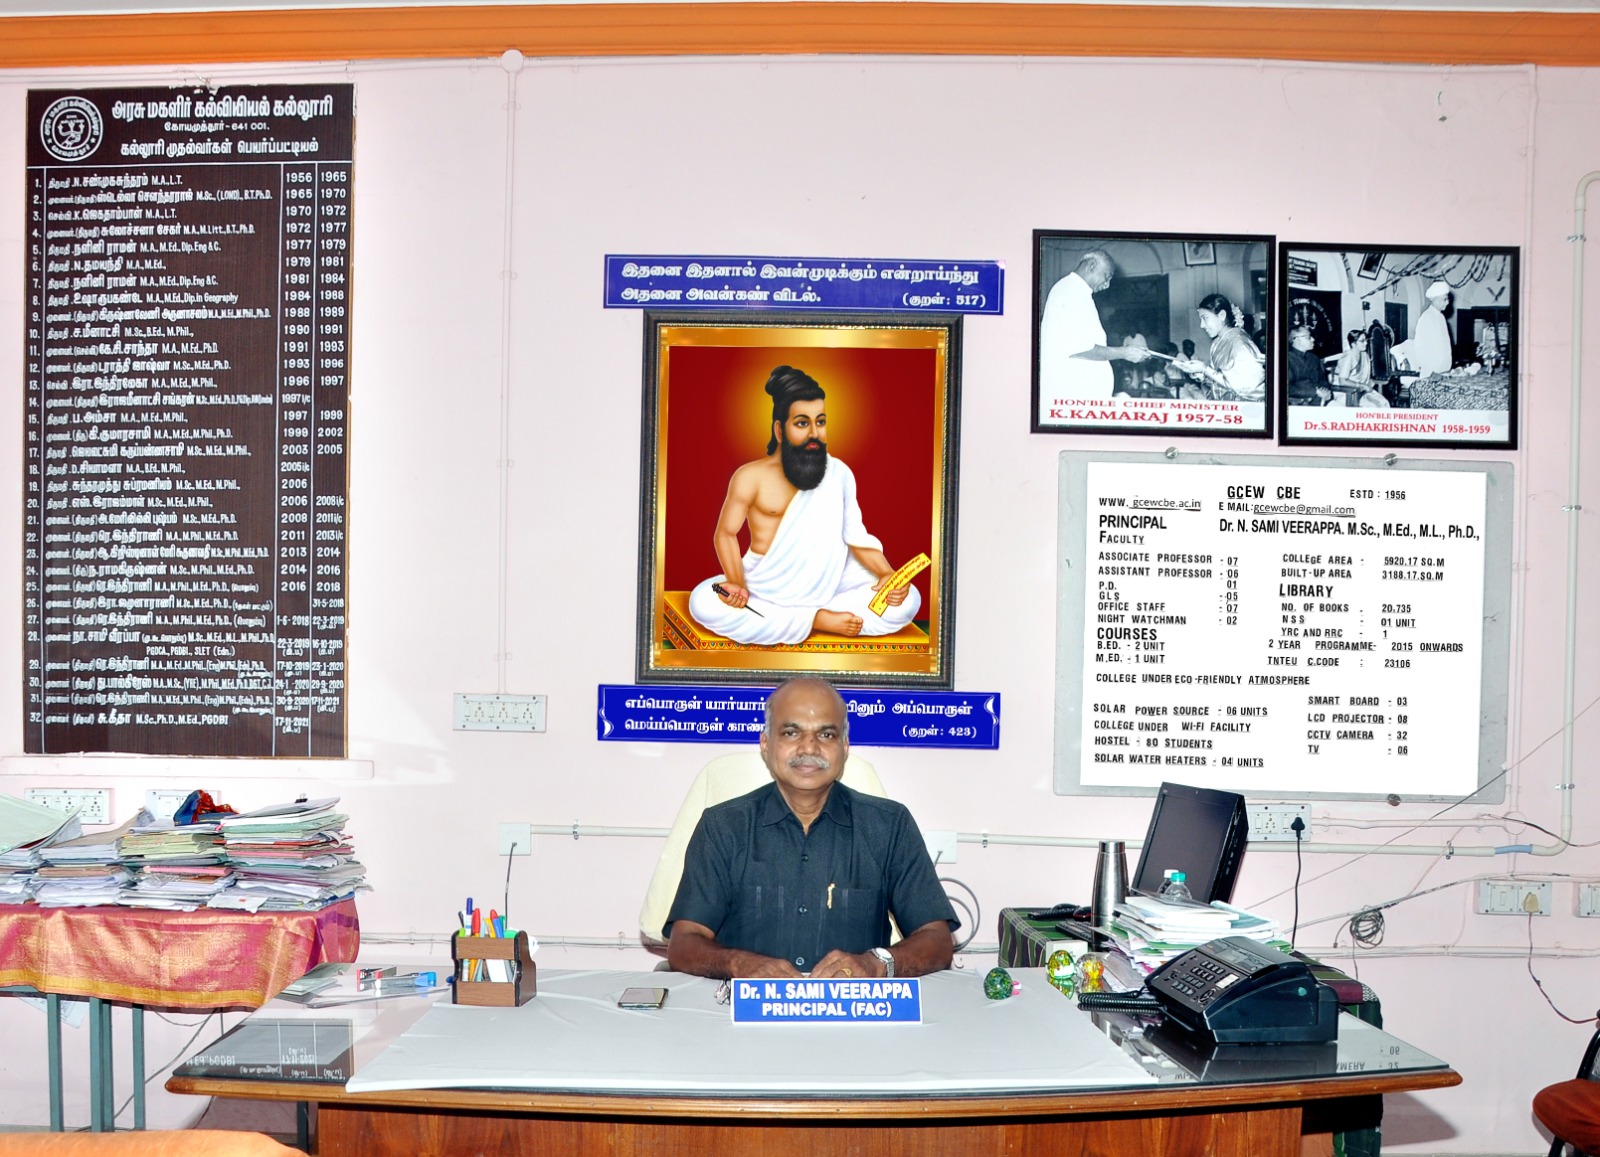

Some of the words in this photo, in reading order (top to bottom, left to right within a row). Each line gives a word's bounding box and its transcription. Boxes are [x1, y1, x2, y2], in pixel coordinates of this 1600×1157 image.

[112, 100, 146, 122] அரசு
[148, 95, 192, 118] மகளிர்
[195, 96, 270, 118] கல்வியியல்
[273, 95, 333, 121] கல்லூரி
[232, 123, 248, 131] 641
[251, 123, 270, 131] 001.
[120, 139, 165, 158] கல்லூரி
[167, 138, 233, 157] முதல்வர்கள்
[286, 173, 312, 183] 1956
[321, 172, 347, 182] 1965
[286, 189, 312, 199] 1965
[321, 189, 346, 198] 1970
[286, 206, 312, 216] 1970
[321, 206, 346, 215] 1972
[622, 263, 682, 278] இதனை
[686, 261, 756, 279] இதனால்
[881, 263, 980, 285] என்றாய்ந்து
[204, 292, 239, 304] Geography
[621, 288, 682, 303] அதனை
[686, 285, 770, 301] அவன்கண்
[774, 286, 821, 302] விடல்.
[903, 293, 950, 307] (குறள்:
[956, 295, 986, 307] 517)
[1124, 400, 1167, 409] CHIEF
[1170, 402, 1239, 411] MINISTER
[1049, 408, 1170, 424] K.KAMARAJ
[1175, 412, 1243, 425] 1957-58
[1392, 412, 1438, 421] PRESIDENT
[283, 427, 308, 437] 1999
[318, 428, 343, 437] 2002
[1304, 421, 1436, 434] Dr.S.RADHAKRISHNAN
[1442, 424, 1491, 435] 1958-1959
[282, 445, 308, 455] 2003
[317, 444, 343, 454] 2005
[1228, 485, 1264, 499] GCEW
[1277, 487, 1300, 499] CBE
[1350, 489, 1373, 498] ESTD
[1385, 490, 1405, 499] 1956
[1133, 498, 1201, 508] gcewcbe.ac.in
[1100, 515, 1167, 529] PRINCIPAL
[1220, 519, 1233, 532] Dr.
[1238, 519, 1248, 532] N.
[1252, 520, 1279, 533] SAMI
[1348, 522, 1380, 538] M.Sc.,
[1383, 523, 1416, 539] M.Ed.,
[1420, 524, 1445, 540] M.L.,
[1449, 525, 1479, 541] Ph.D.,
[1099, 552, 1149, 561] ASSOCIATE
[1158, 554, 1211, 563] PROFESSOR
[1228, 557, 1238, 565] 07
[1283, 554, 1321, 564] COLLEGE
[1328, 556, 1352, 564] AREA
[1385, 557, 1417, 565] 5920.17
[1099, 566, 1150, 576] ASSISTANT
[1158, 568, 1211, 578] PROFESSOR
[1228, 569, 1238, 578] 06
[1282, 568, 1325, 577] BUILT-UP
[1329, 569, 1351, 578] AREA
[281, 582, 306, 592] 2016
[316, 582, 341, 592] 2018
[1099, 581, 1116, 590] P.D.
[1227, 580, 1236, 589] 01
[1227, 592, 1237, 601] 05
[1280, 584, 1333, 598] LIBRARY
[1098, 602, 1128, 611] OFFICE
[1137, 603, 1165, 611] STAFF
[1226, 603, 1237, 613] 07
[1282, 603, 1296, 611] NO.
[1304, 603, 1313, 611] OF
[1320, 603, 1348, 612] BOOKS
[1098, 614, 1125, 623] NIGHT
[1132, 615, 1186, 624] WATCHMAN
[1227, 616, 1237, 625] 02
[1381, 618, 1390, 626] 01
[1396, 619, 1415, 627] UNIT
[1098, 627, 1157, 642] COURSES
[1282, 627, 1298, 636] YRC
[1303, 629, 1321, 637] AND
[1325, 629, 1342, 637] RRC
[1098, 641, 1120, 649] B.ED.
[1136, 641, 1140, 649] 2
[1144, 642, 1164, 650] UNIT
[1269, 639, 1273, 647] 2
[1279, 640, 1300, 649] YEAR
[1392, 642, 1412, 651] 2015
[1420, 643, 1463, 652] ONWARDS
[1096, 653, 1122, 662] M.ED.
[1136, 654, 1139, 662] 1
[1144, 655, 1165, 663] UNIT
[1268, 656, 1297, 665] TNTEU
[1308, 658, 1339, 666] C.CODE
[1385, 659, 1410, 668] 23106
[1097, 674, 1136, 683] COLLEGE
[1142, 674, 1171, 683] UNDER
[1249, 676, 1309, 685] ATMOSPHERE
[625, 695, 702, 712] எப்பொருள்
[892, 700, 973, 717] அப்பொருள்
[1309, 696, 1339, 705] SMART
[1350, 697, 1379, 705] BOARD
[1397, 697, 1407, 705] 03
[1094, 704, 1125, 713] SOLAR
[1135, 706, 1167, 716] POWER
[1173, 707, 1209, 715] SOURCE
[1227, 706, 1236, 715] 06
[1241, 707, 1267, 716] UNITS
[1308, 713, 1325, 722] LCD
[1333, 714, 1384, 724] PROJECTOR
[1398, 715, 1407, 723] 08
[625, 717, 724, 734] மெய்ப்பொருள்
[902, 725, 944, 738] (குறள்:
[948, 726, 977, 738] 423)
[1095, 720, 1134, 730] COLLEGE
[1138, 722, 1168, 732] UNDER
[1182, 722, 1204, 730] WI-FI
[1211, 722, 1250, 732] FACILITY
[1308, 730, 1330, 739] CCTV
[1337, 731, 1373, 739] CAMERA
[1397, 731, 1407, 739] 32
[1095, 736, 1129, 745] HOSTEL
[1147, 738, 1158, 747] 80
[1165, 738, 1212, 748] STUDENTS
[1308, 745, 1319, 753] TV
[1398, 746, 1407, 754] 06
[1095, 753, 1123, 762] SOLAR
[1130, 755, 1161, 764] WATER
[1166, 756, 1206, 765] HEATERS
[1222, 757, 1233, 766] 04
[1238, 758, 1263, 767] UNITS
[740, 983, 760, 999] Dr.
[765, 983, 780, 999] N.
[785, 983, 824, 999] SAMI
[829, 983, 912, 999] VEERAPPA
[762, 1003, 846, 1016] PRINCIPAL
[851, 1002, 892, 1017] (FAC)
